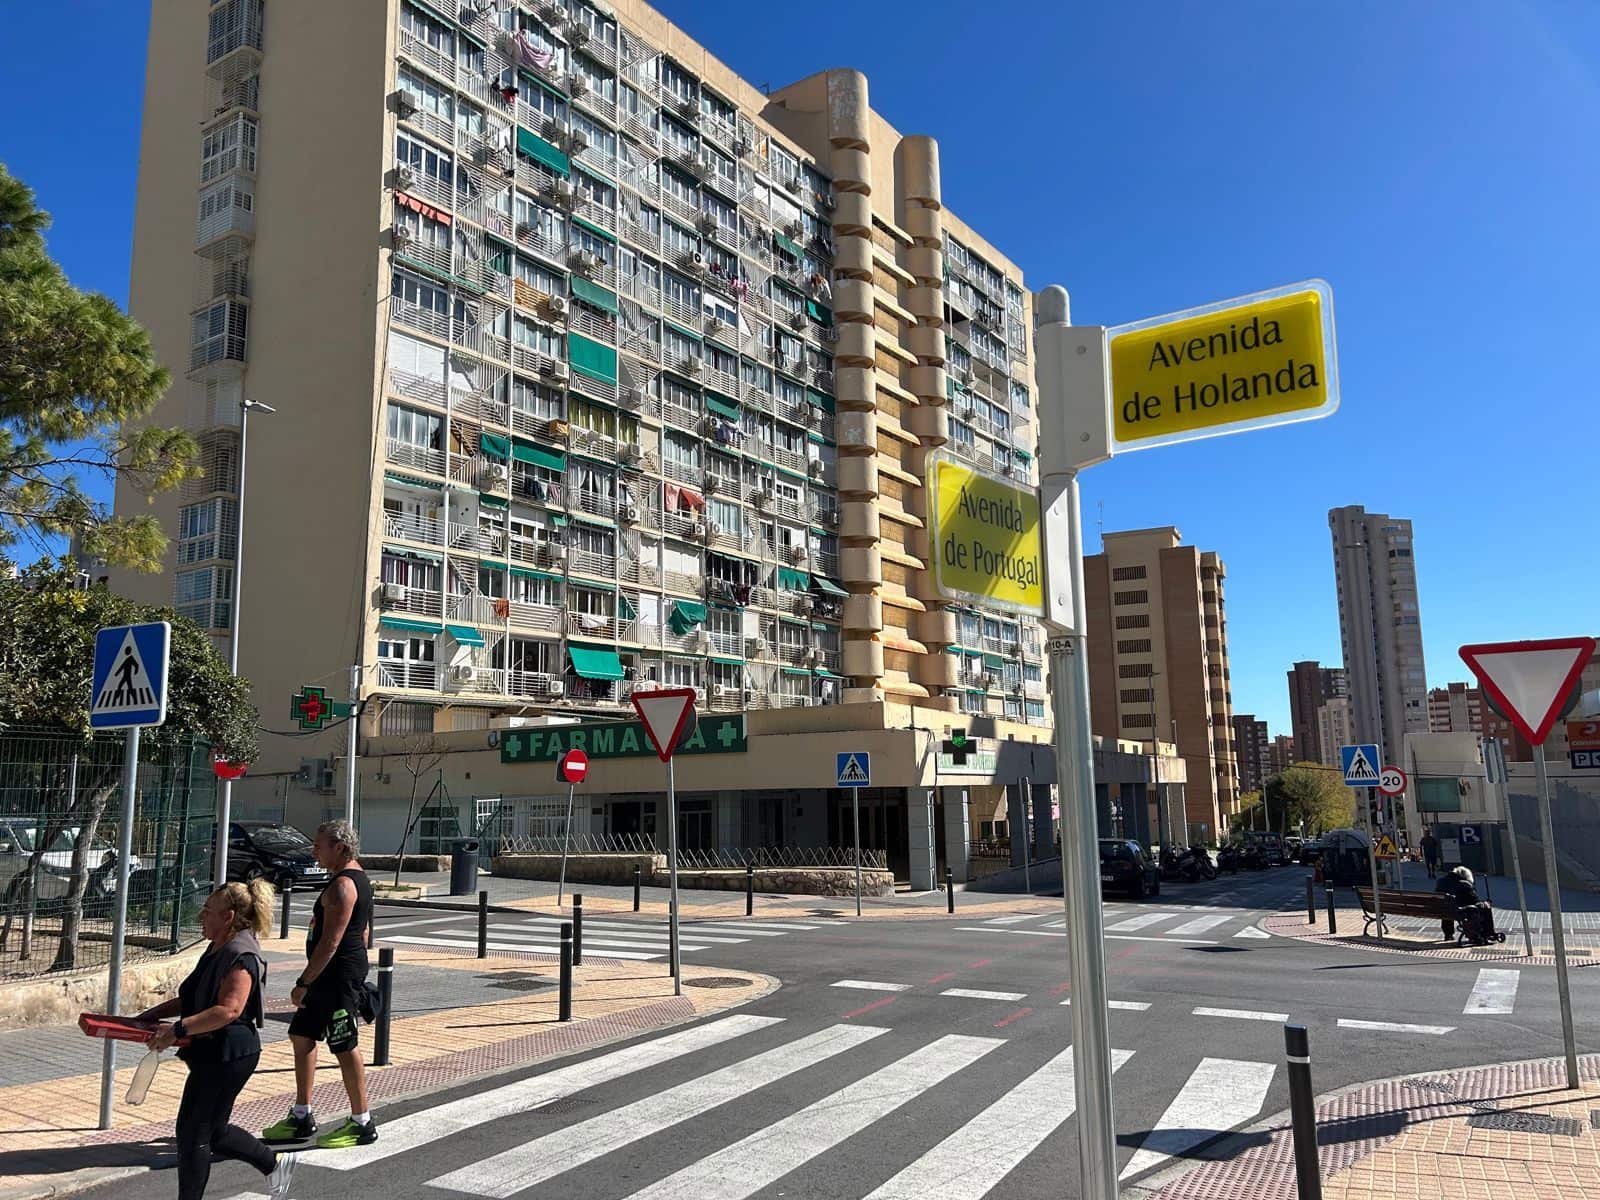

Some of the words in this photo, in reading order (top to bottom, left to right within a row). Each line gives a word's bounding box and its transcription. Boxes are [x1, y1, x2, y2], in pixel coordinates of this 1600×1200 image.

[1148, 316, 1283, 371] Avenida
[1122, 392, 1161, 423] de
[1174, 359, 1319, 413] Holanda
[958, 485, 1024, 533] Avenida
[944, 532, 968, 569] de
[973, 541, 1039, 590] Portugal
[530, 722, 706, 757] FARMAA
[1382, 776, 1400, 786] 20
